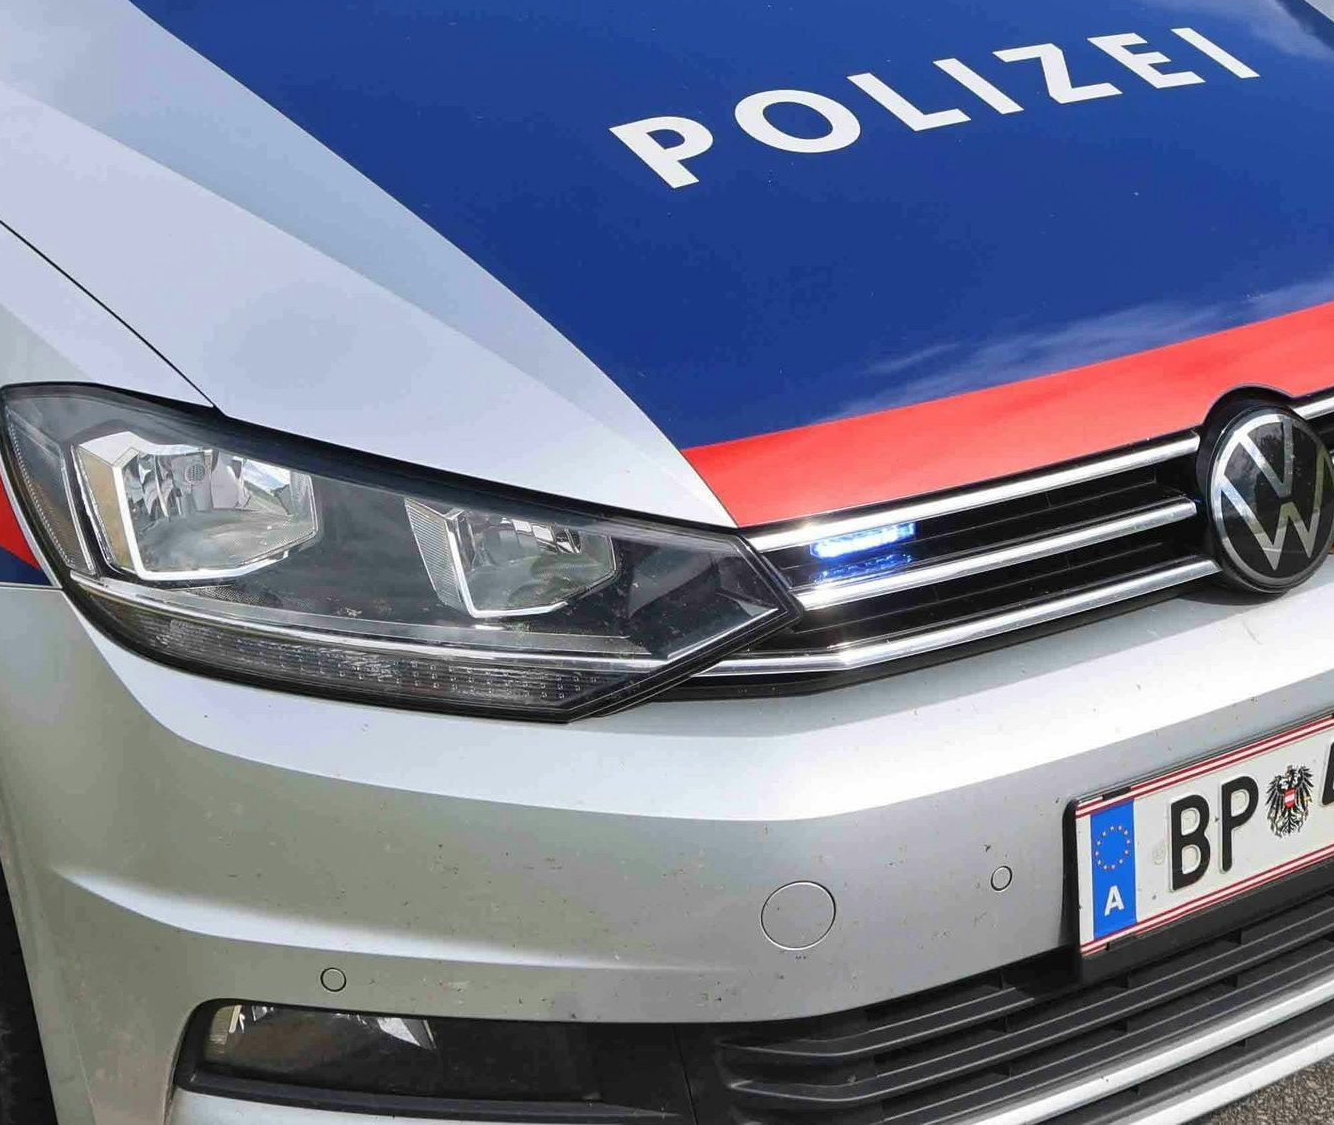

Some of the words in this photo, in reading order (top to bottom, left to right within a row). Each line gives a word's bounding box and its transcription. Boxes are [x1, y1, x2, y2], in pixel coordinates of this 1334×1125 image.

[609, 27, 1261, 189] POLIZEI
[1170, 775, 1260, 892] BP
[1104, 885, 1125, 916] A
